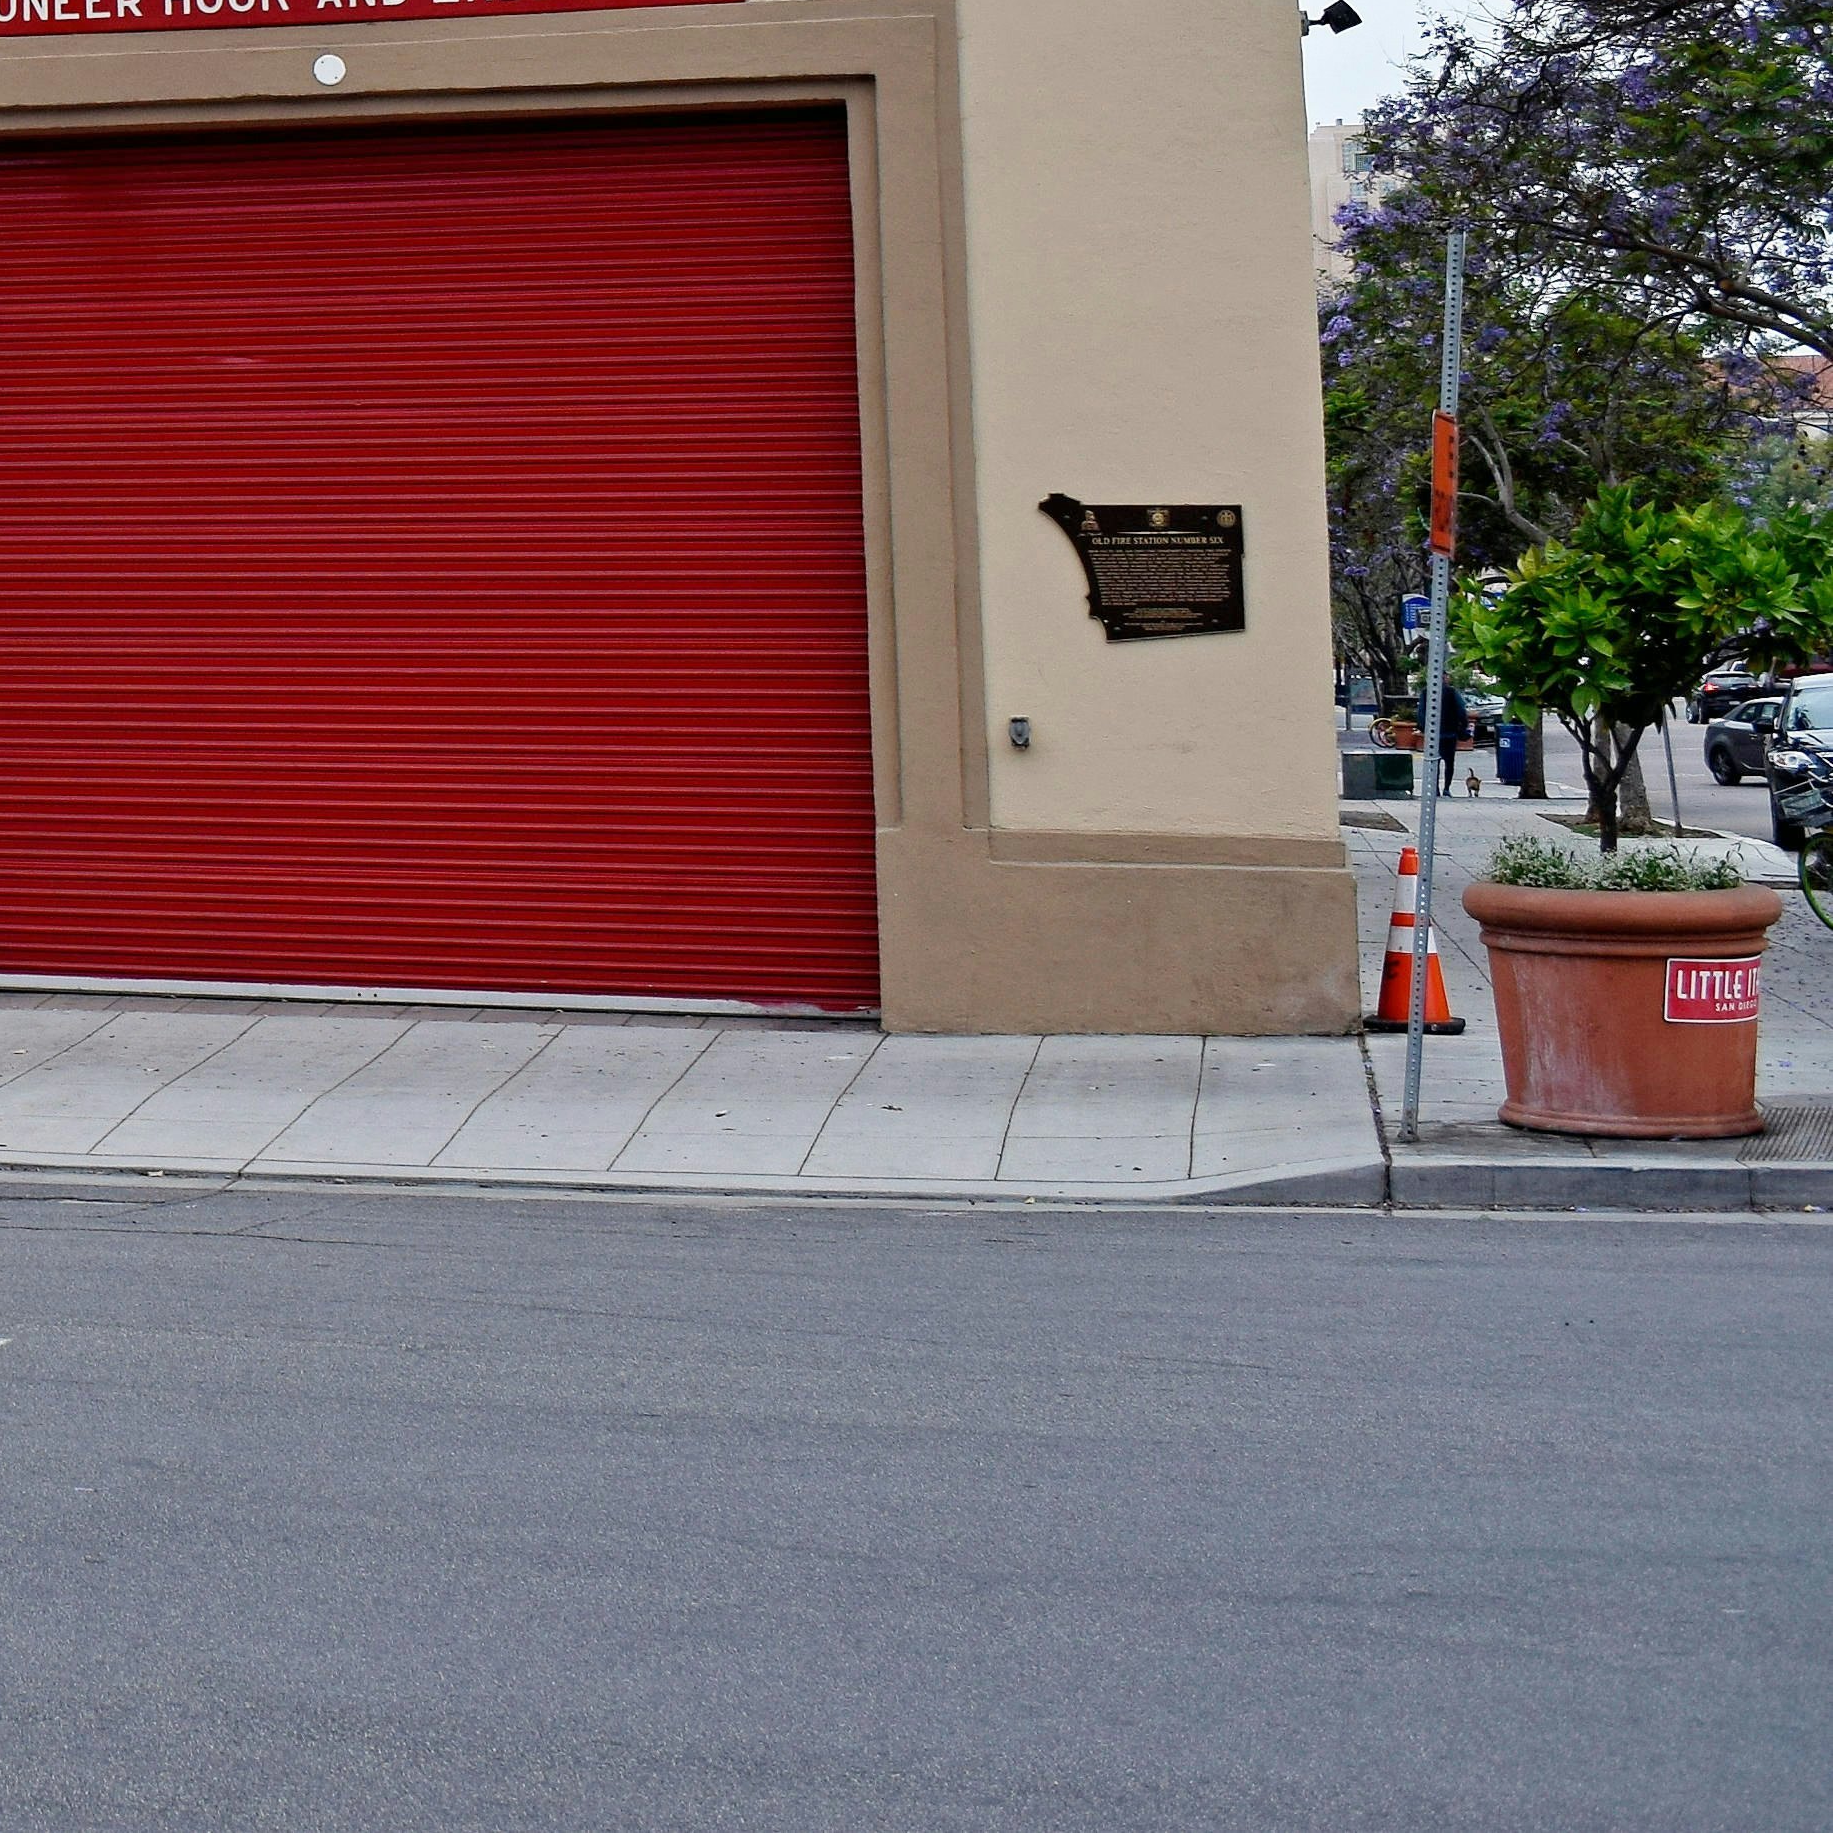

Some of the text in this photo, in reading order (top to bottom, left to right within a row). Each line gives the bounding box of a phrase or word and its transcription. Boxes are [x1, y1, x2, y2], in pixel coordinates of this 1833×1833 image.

[1677, 968, 1760, 999] LITTLE IT
[1715, 1003, 1735, 1012] SAN
